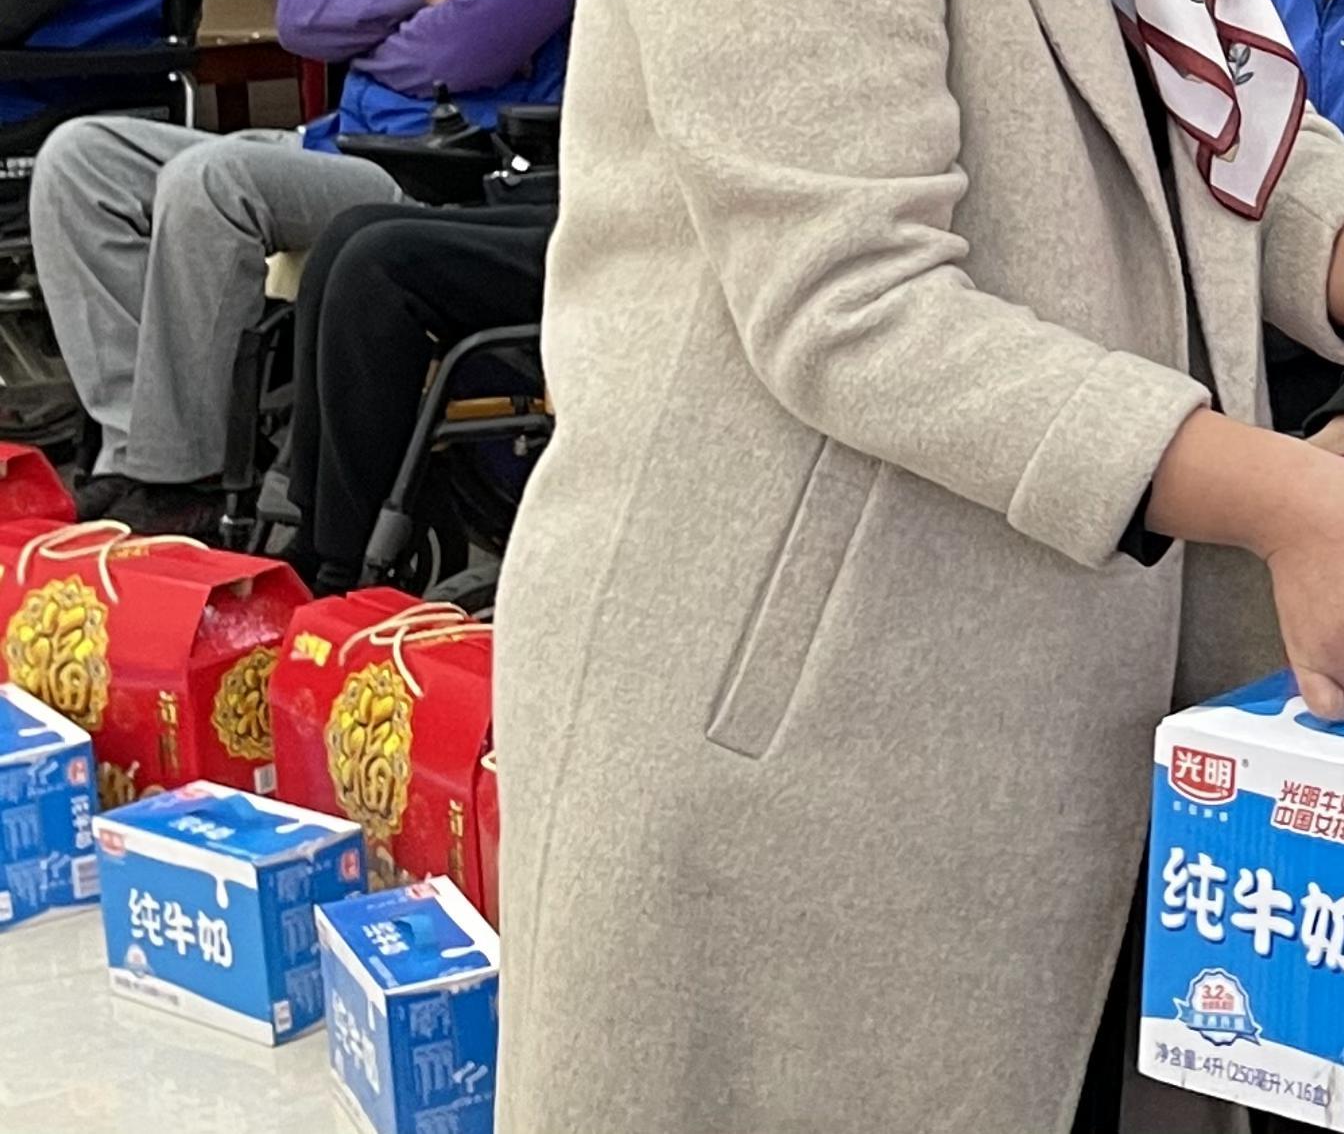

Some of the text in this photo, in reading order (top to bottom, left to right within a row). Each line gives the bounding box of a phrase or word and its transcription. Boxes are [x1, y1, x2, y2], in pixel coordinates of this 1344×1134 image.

[1174, 748, 1234, 790] 光明
[128, 887, 233, 968] 纯牛奶
